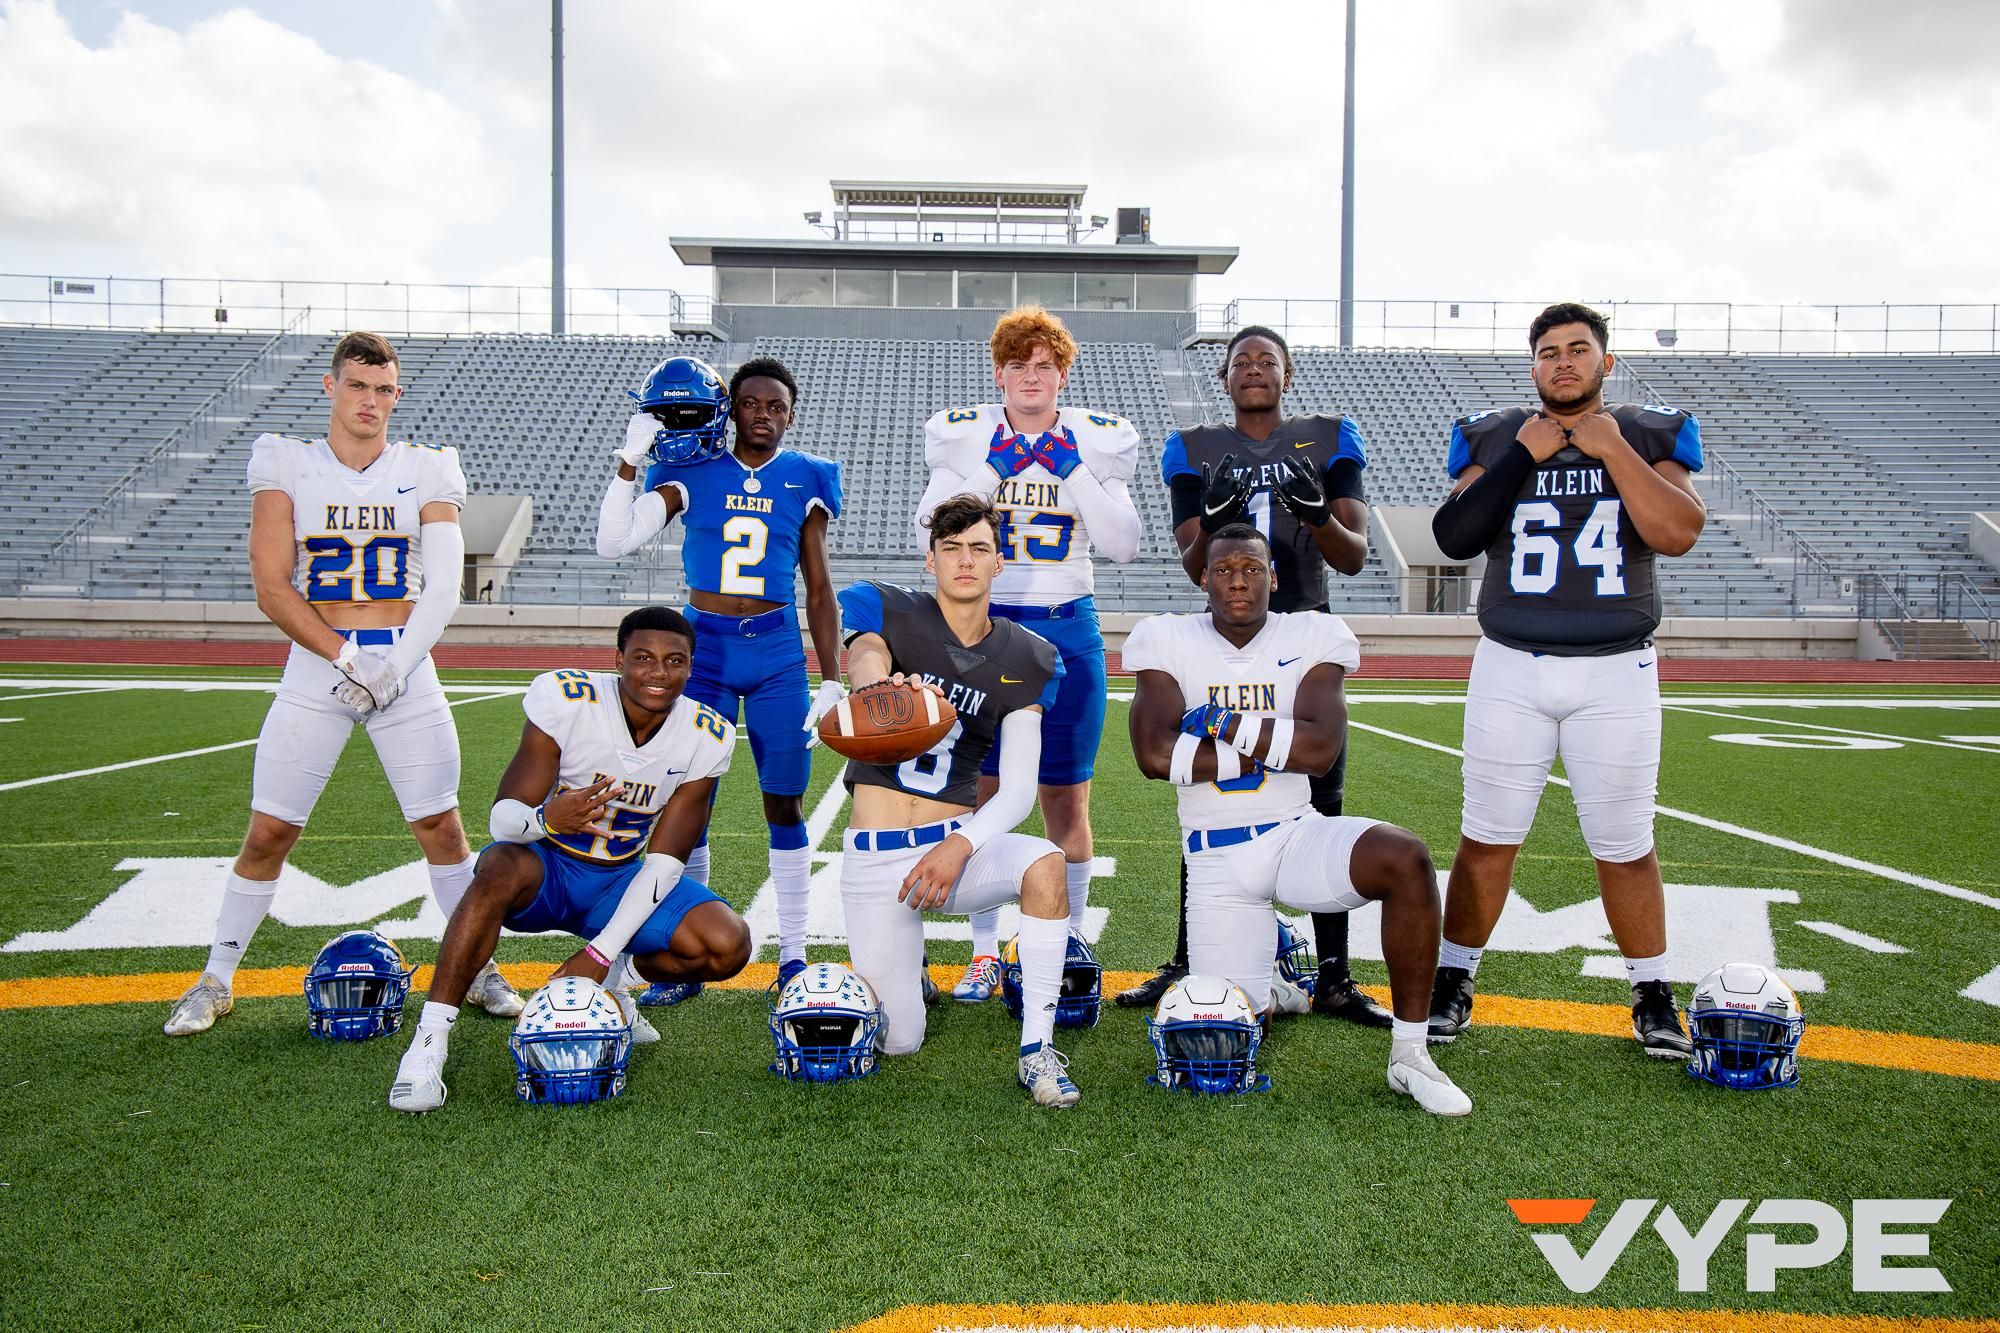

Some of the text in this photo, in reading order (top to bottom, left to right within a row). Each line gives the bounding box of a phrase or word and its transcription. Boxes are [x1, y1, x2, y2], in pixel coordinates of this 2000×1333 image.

[997, 480, 1059, 508] KLEIN
[1535, 468, 1604, 497] KLEIN
[724, 494, 774, 513] KLEIN
[325, 505, 396, 531] KLEIN
[719, 516, 769, 597] 2
[1510, 498, 1628, 597] 64
[304, 535, 411, 604] 20
[1207, 684, 1276, 712] KLEIN
[1725, 1001, 1757, 1010] Riddell
[555, 1021, 586, 1029] Riddell
